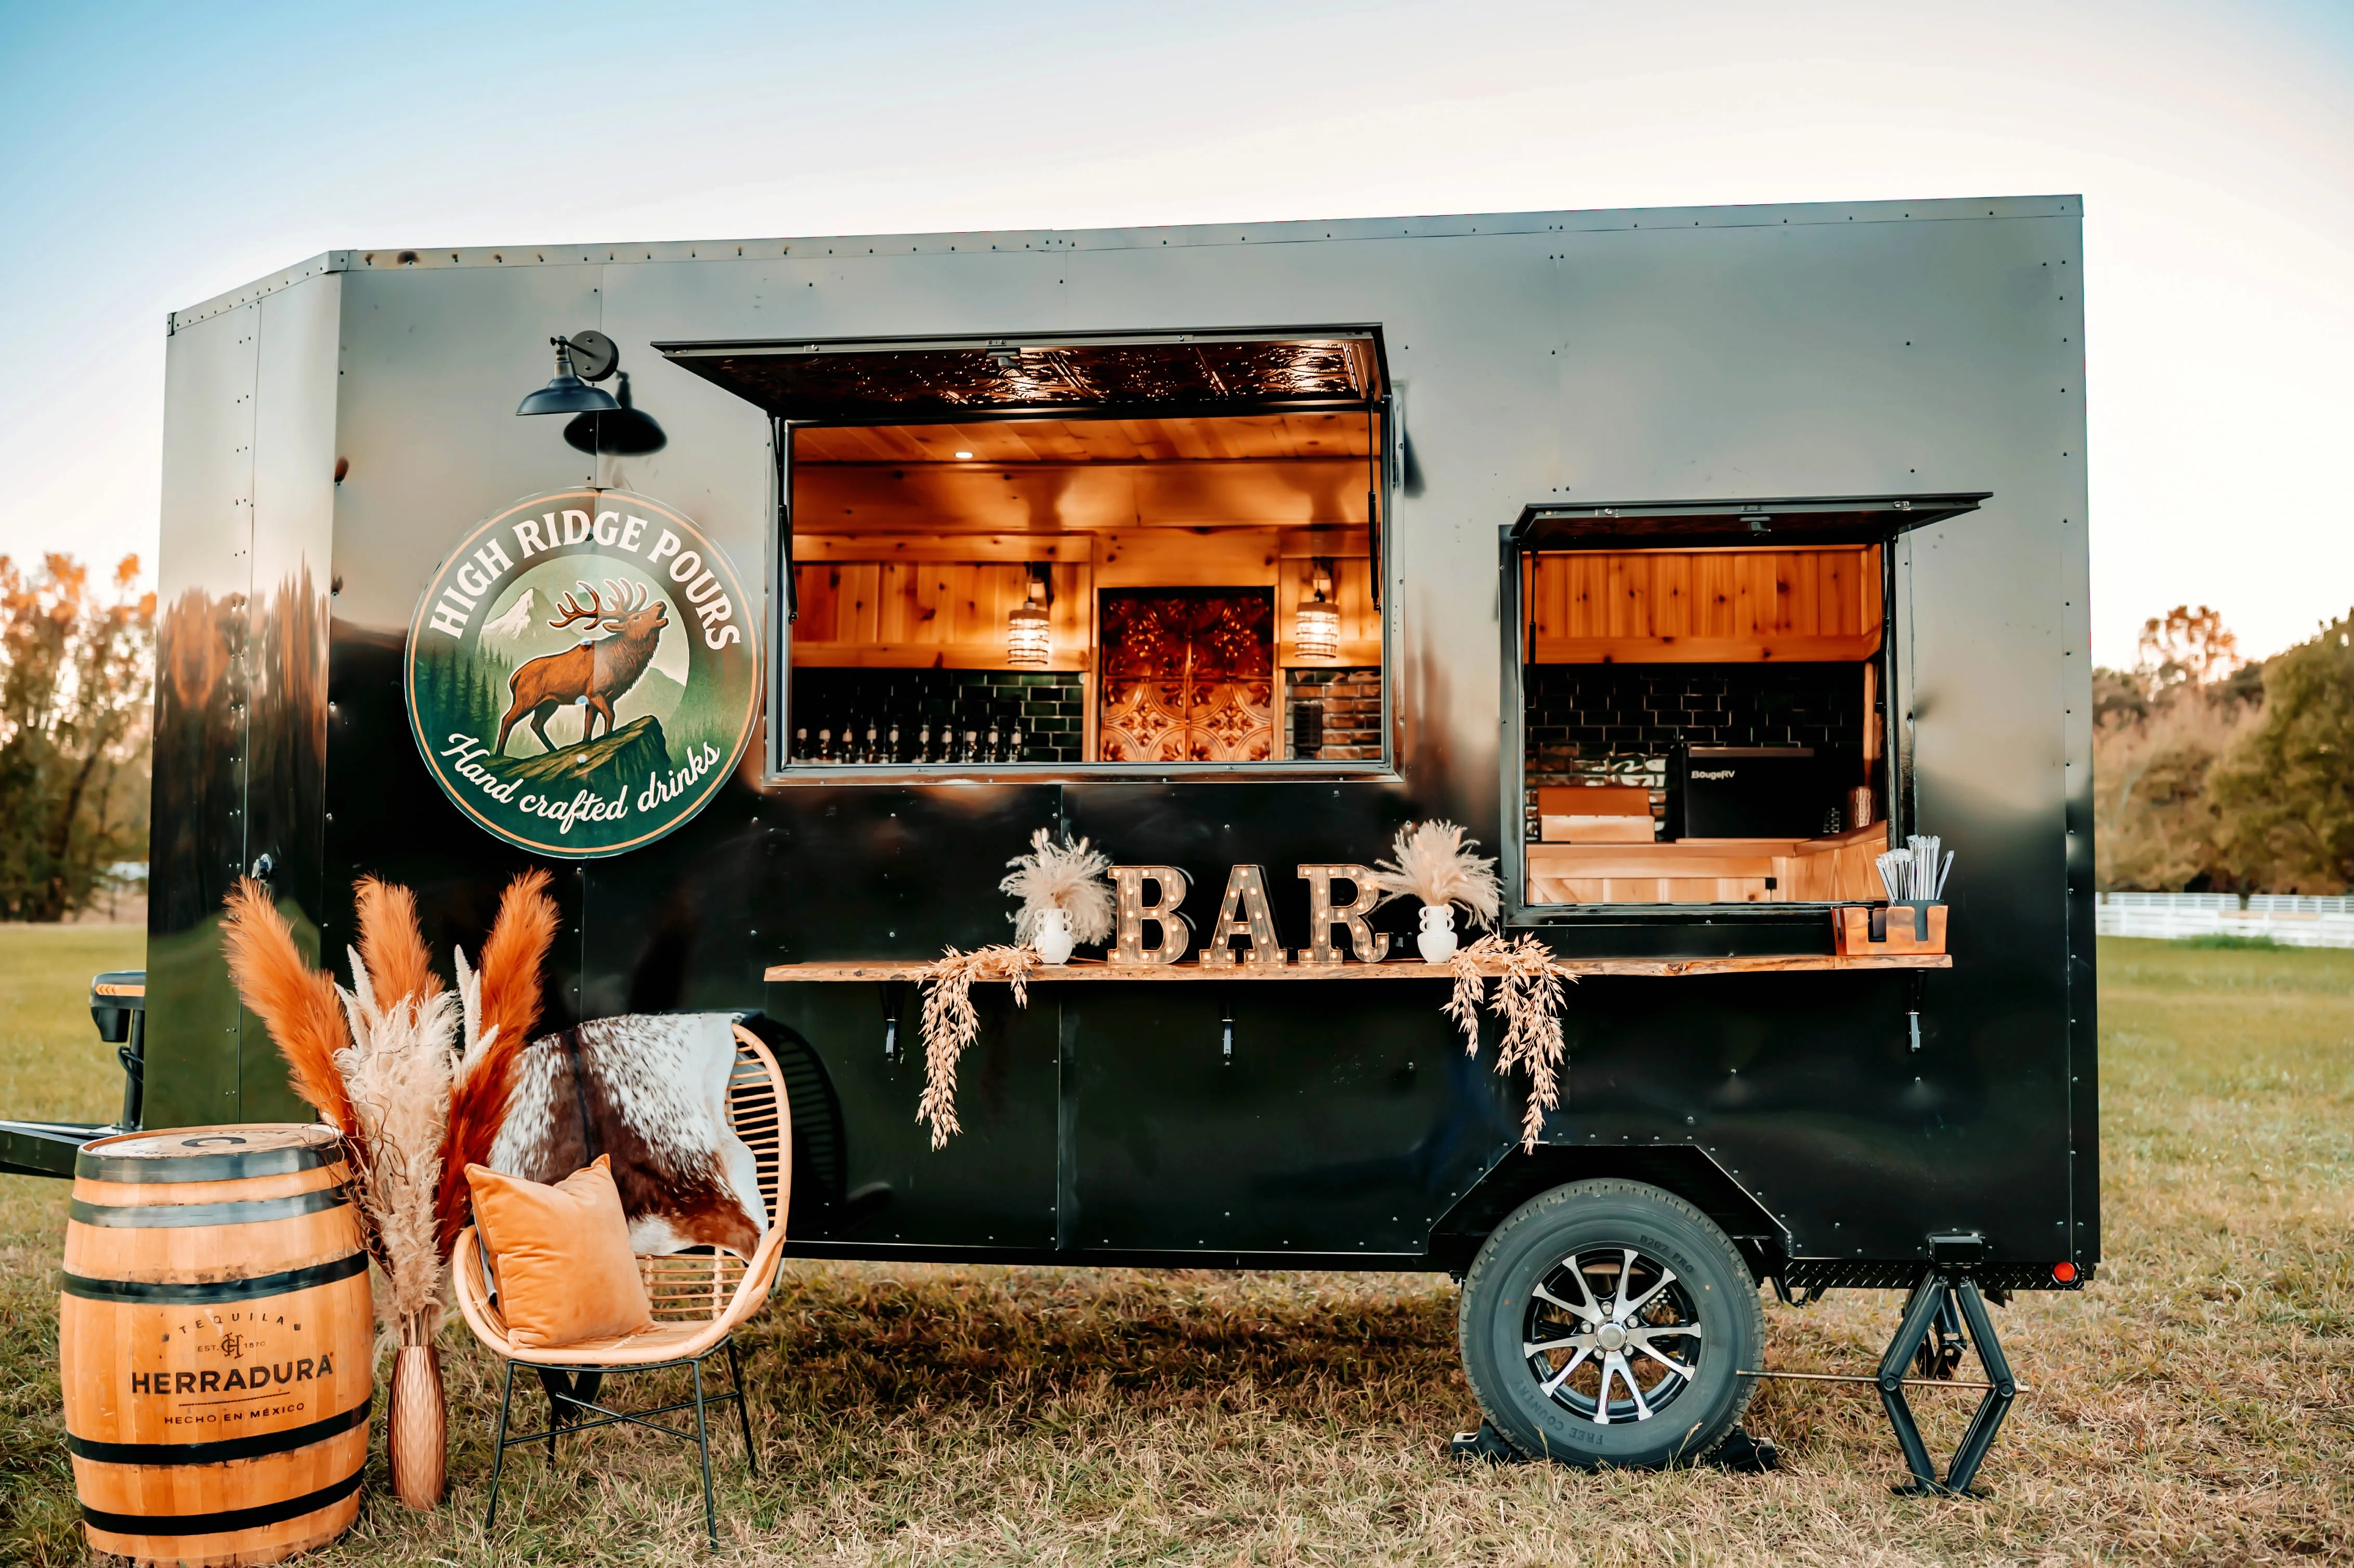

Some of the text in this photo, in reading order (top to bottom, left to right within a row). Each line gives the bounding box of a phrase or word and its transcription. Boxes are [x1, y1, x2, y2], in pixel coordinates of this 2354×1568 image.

[429, 509, 741, 650] HIGH RIDGE POURS
[441, 733, 720, 834] Hand crafted drinks
[1691, 770, 1735, 780] BougeRV
[1107, 864, 1389, 964] BAR
[1671, 1252, 1694, 1273] PRO
[179, 1312, 284, 1335] TEQUILA
[132, 1354, 333, 1394] HERRADURA
[164, 1403, 304, 1424] HECHO EN MÉXICO
[1569, 1427, 1604, 1445] FREE
